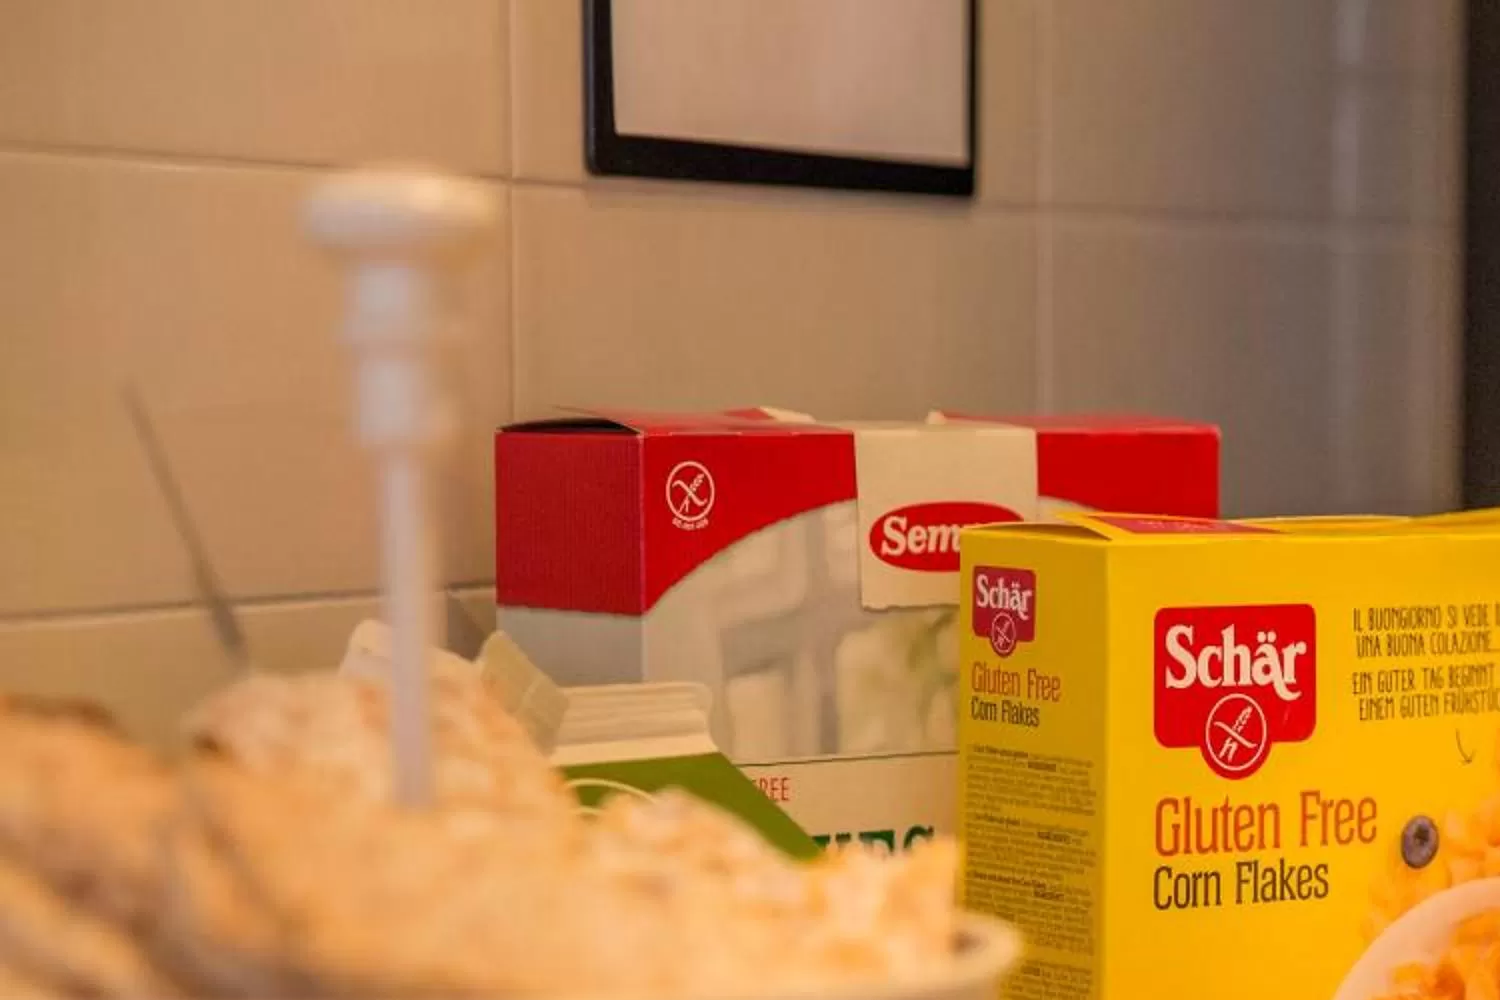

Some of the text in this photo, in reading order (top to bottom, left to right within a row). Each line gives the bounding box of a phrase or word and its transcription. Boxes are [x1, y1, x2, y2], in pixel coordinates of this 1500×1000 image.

[881, 516, 961, 557] Sem
[975, 573, 1033, 621] Schär
[1353, 607, 1364, 632] IL
[1368, 605, 1442, 632] BUONGIORNO
[1447, 604, 1459, 630] SI
[1463, 603, 1490, 627] VEDE
[1165, 623, 1308, 701] Schär
[1356, 633, 1382, 658] UNA
[1386, 632, 1427, 657] BUONA
[972, 661, 1062, 703] Gluten Free
[1352, 671, 1373, 696] EIN
[1377, 668, 1416, 693] GUTER
[1421, 666, 1445, 690] TAG
[1448, 662, 1495, 688] BEGINNT
[971, 696, 1040, 728] Corn Flakes
[1359, 698, 1396, 721] EINEM
[1400, 693, 1439, 718] GUTEN
[752, 776, 792, 802] REE
[1155, 789, 1378, 857] Gluten Free
[1153, 858, 1329, 911] Corn Flakes
